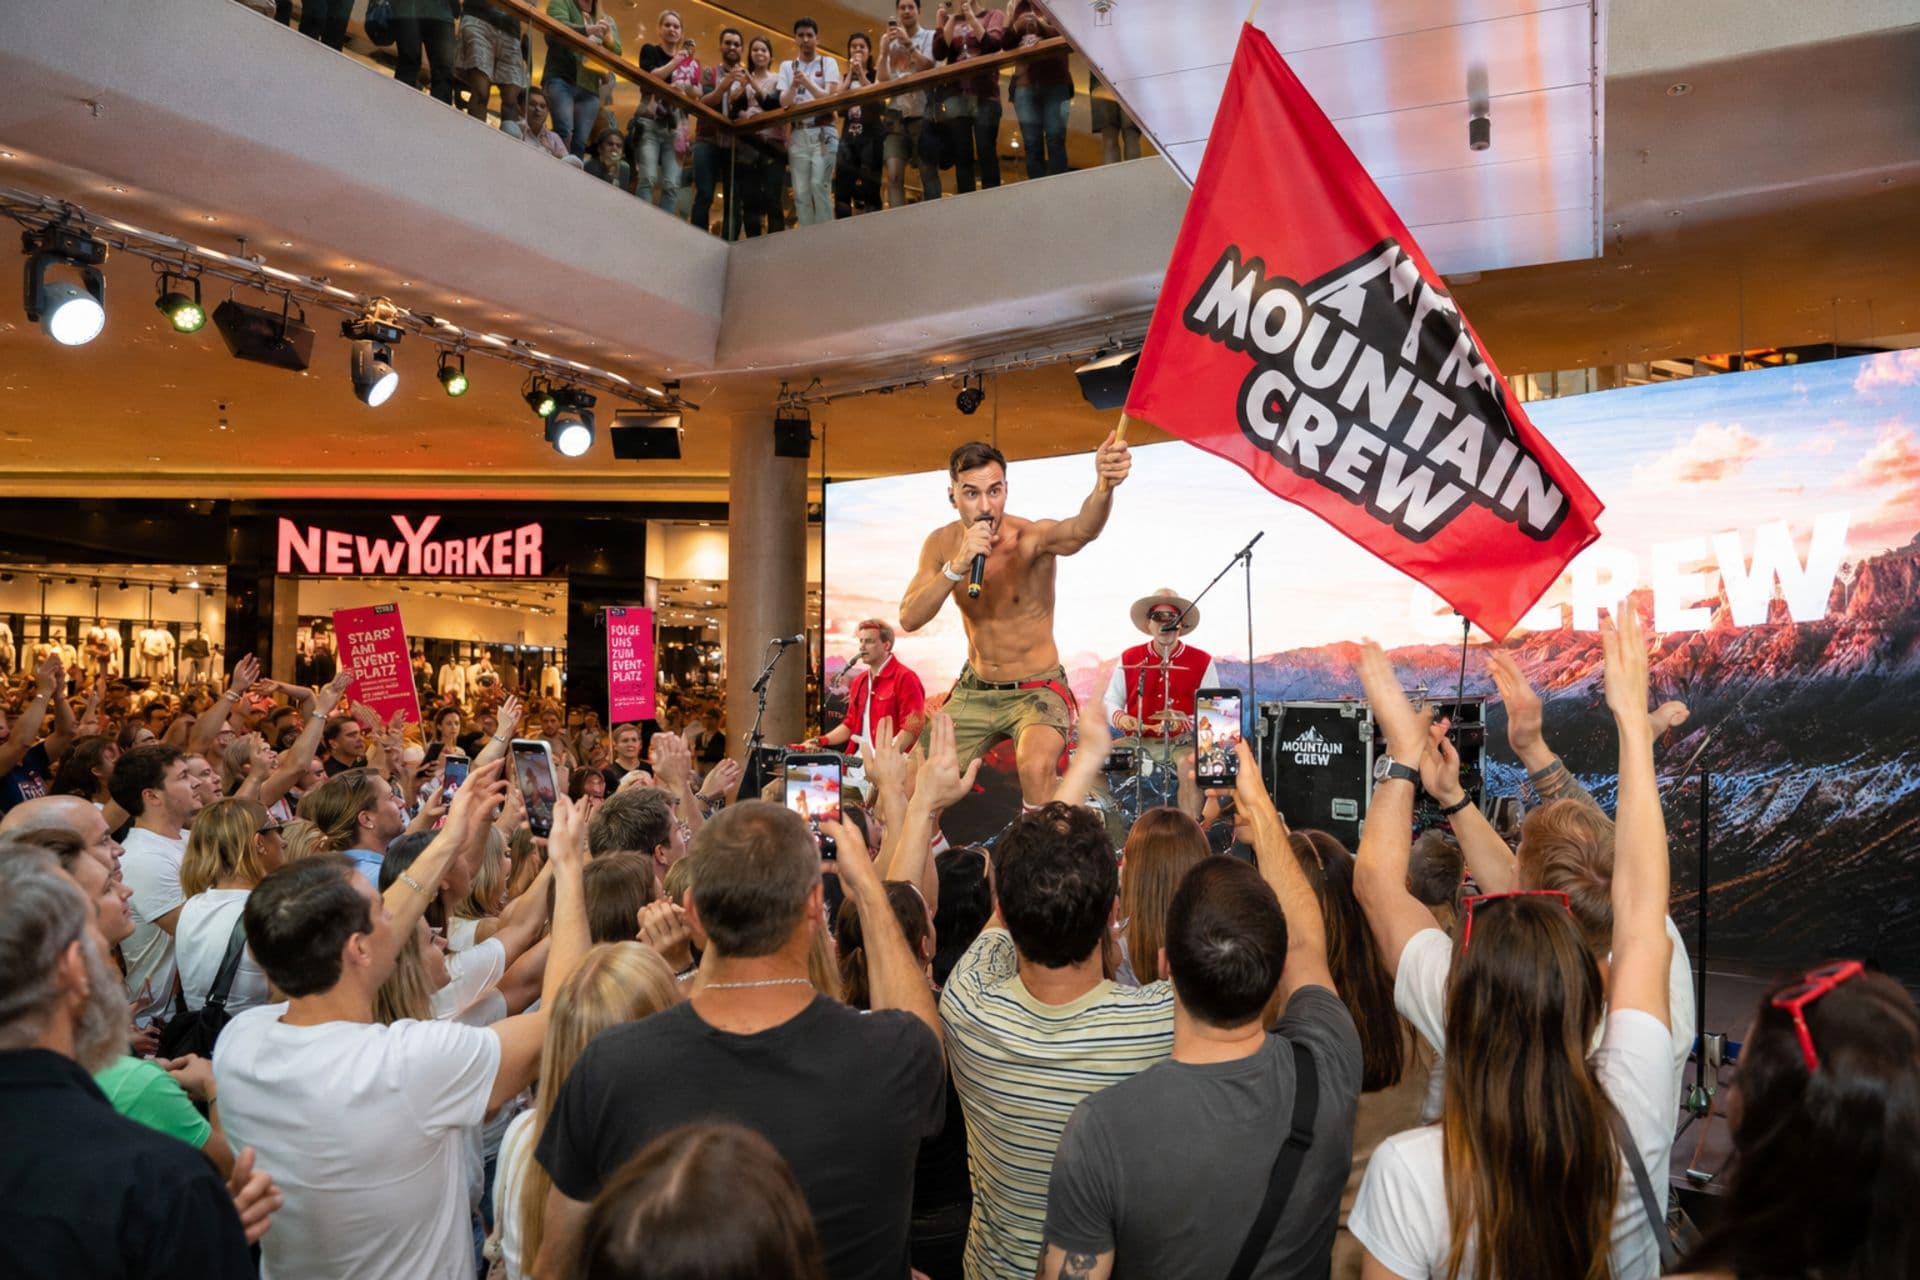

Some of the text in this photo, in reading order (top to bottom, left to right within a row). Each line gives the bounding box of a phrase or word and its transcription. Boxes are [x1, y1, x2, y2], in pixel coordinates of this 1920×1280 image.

[1192, 259, 1564, 532] MOUNTAIN
[1245, 369, 1467, 533] CREW
[611, 624, 640, 636] FOLGE
[611, 637, 632, 648] UNS
[612, 648, 634, 660] ZUM
[355, 664, 398, 681] PLATZ
[612, 671, 642, 683] PLATZ
[1281, 741, 1343, 754] MOUNTAIN
[1294, 752, 1330, 766] CREW
